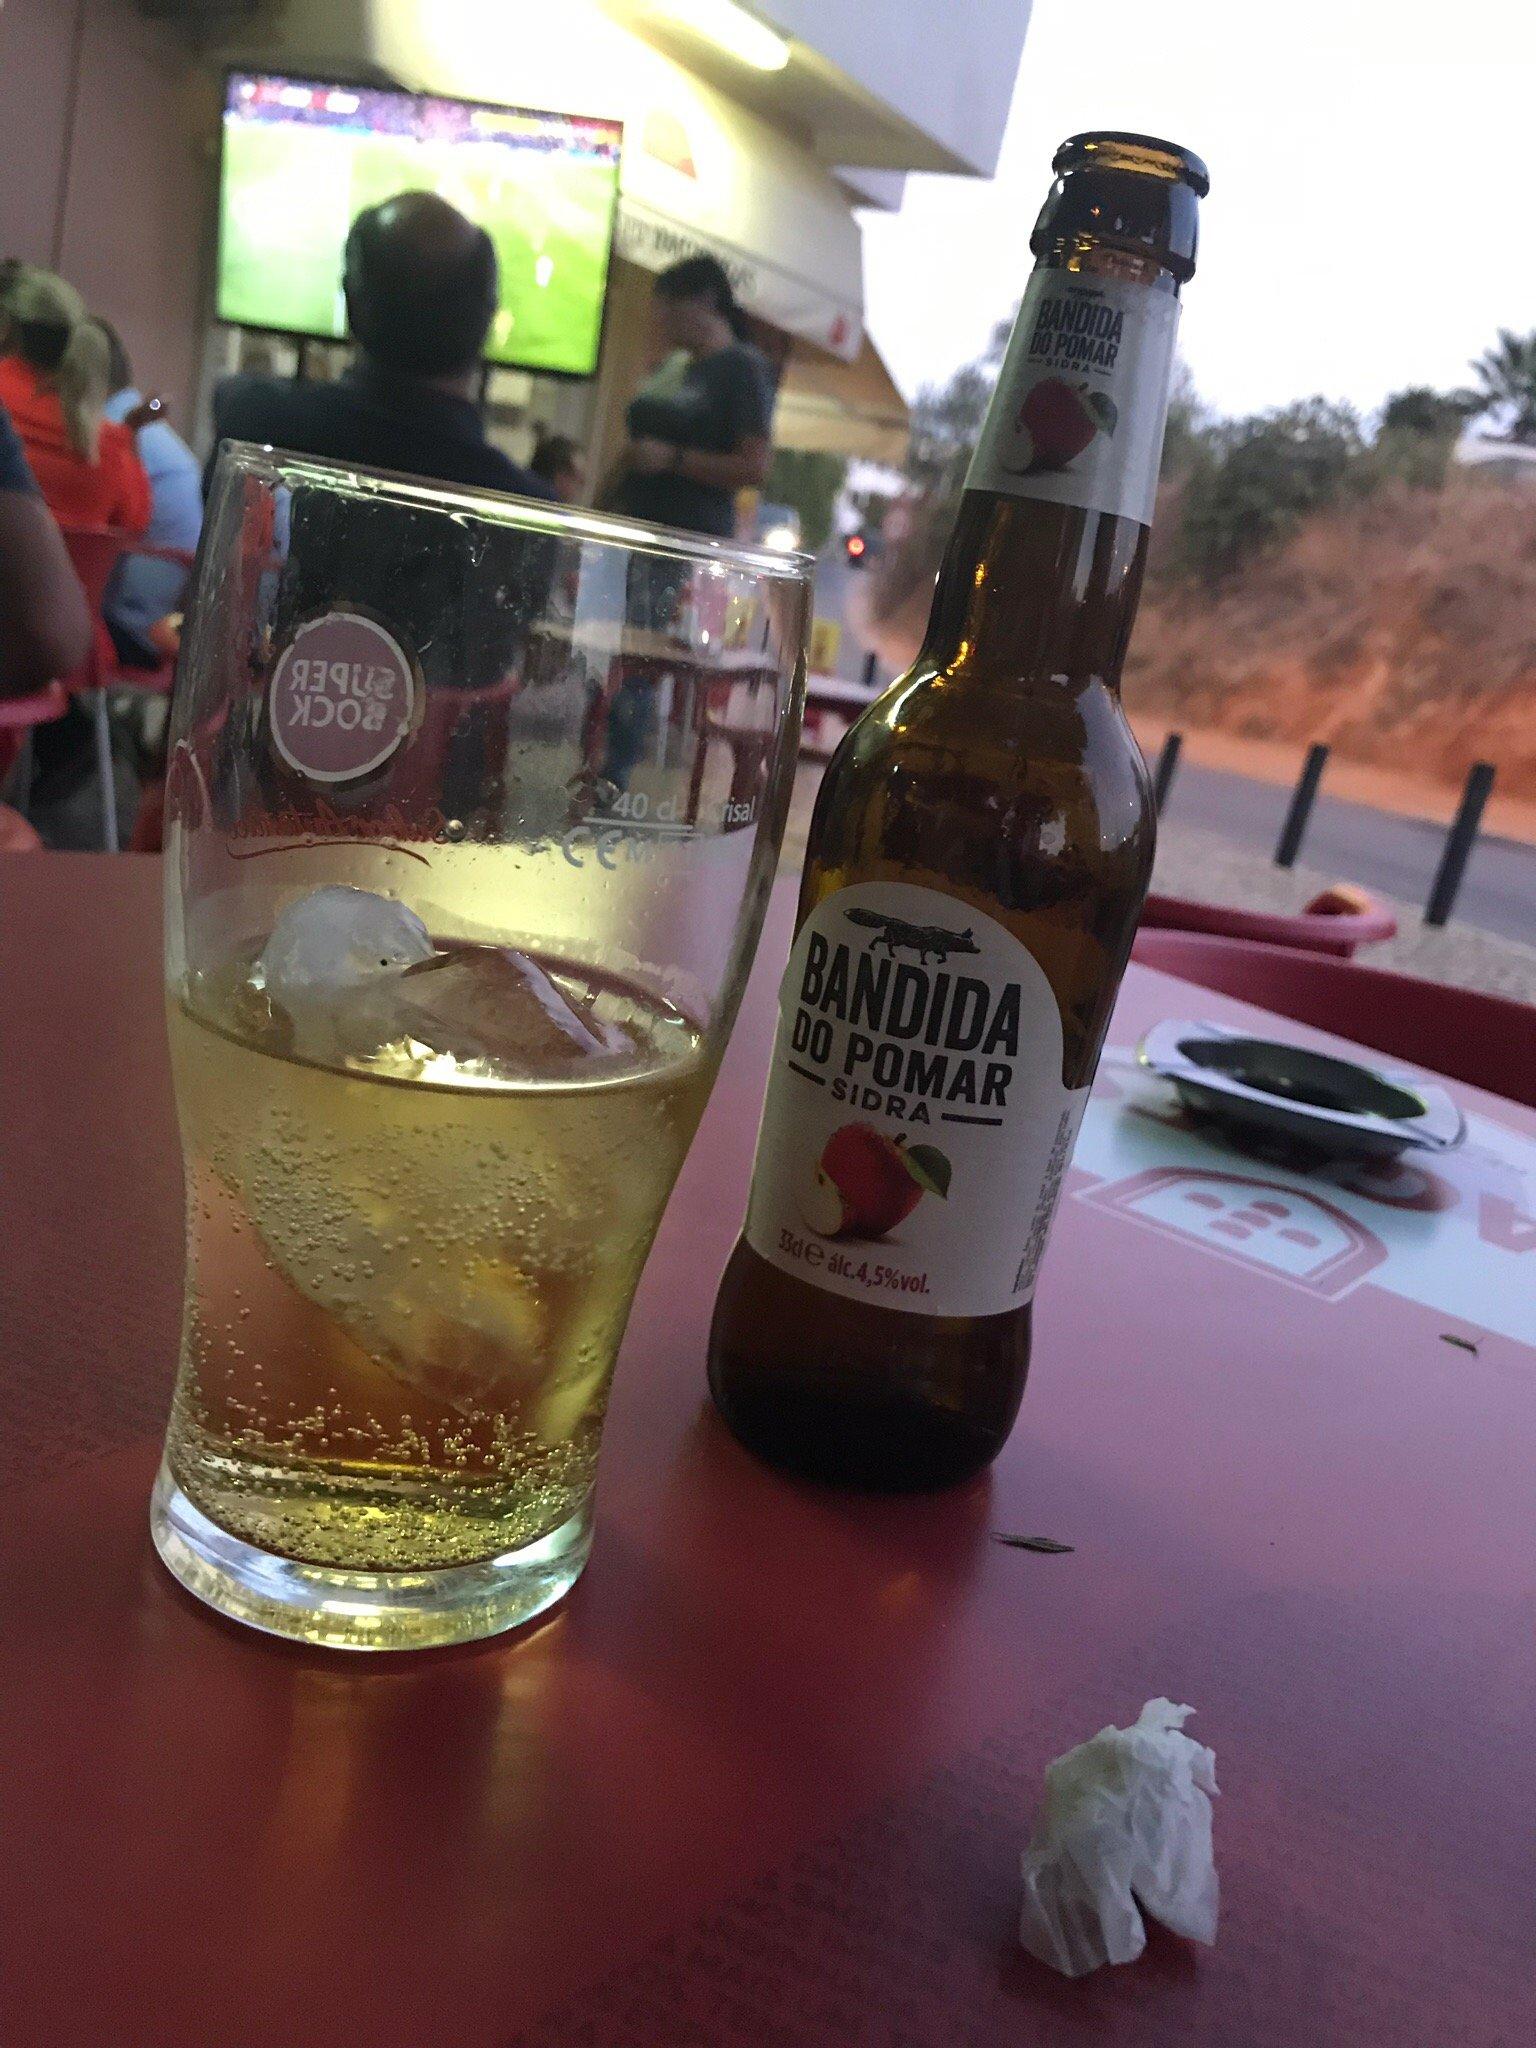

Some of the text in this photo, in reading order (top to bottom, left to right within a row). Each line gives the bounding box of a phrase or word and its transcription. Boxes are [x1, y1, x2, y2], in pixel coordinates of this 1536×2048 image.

[1035, 299, 1125, 344] BANDIDA
[1029, 331, 1119, 370] DO POMAR
[1044, 359, 1091, 374] SIDRA
[611, 792, 649, 820] 40
[800, 930, 1022, 1057] BANDIDA
[791, 1007, 1014, 1107] DO POMAR
[831, 1078, 931, 1125] SIDRA
